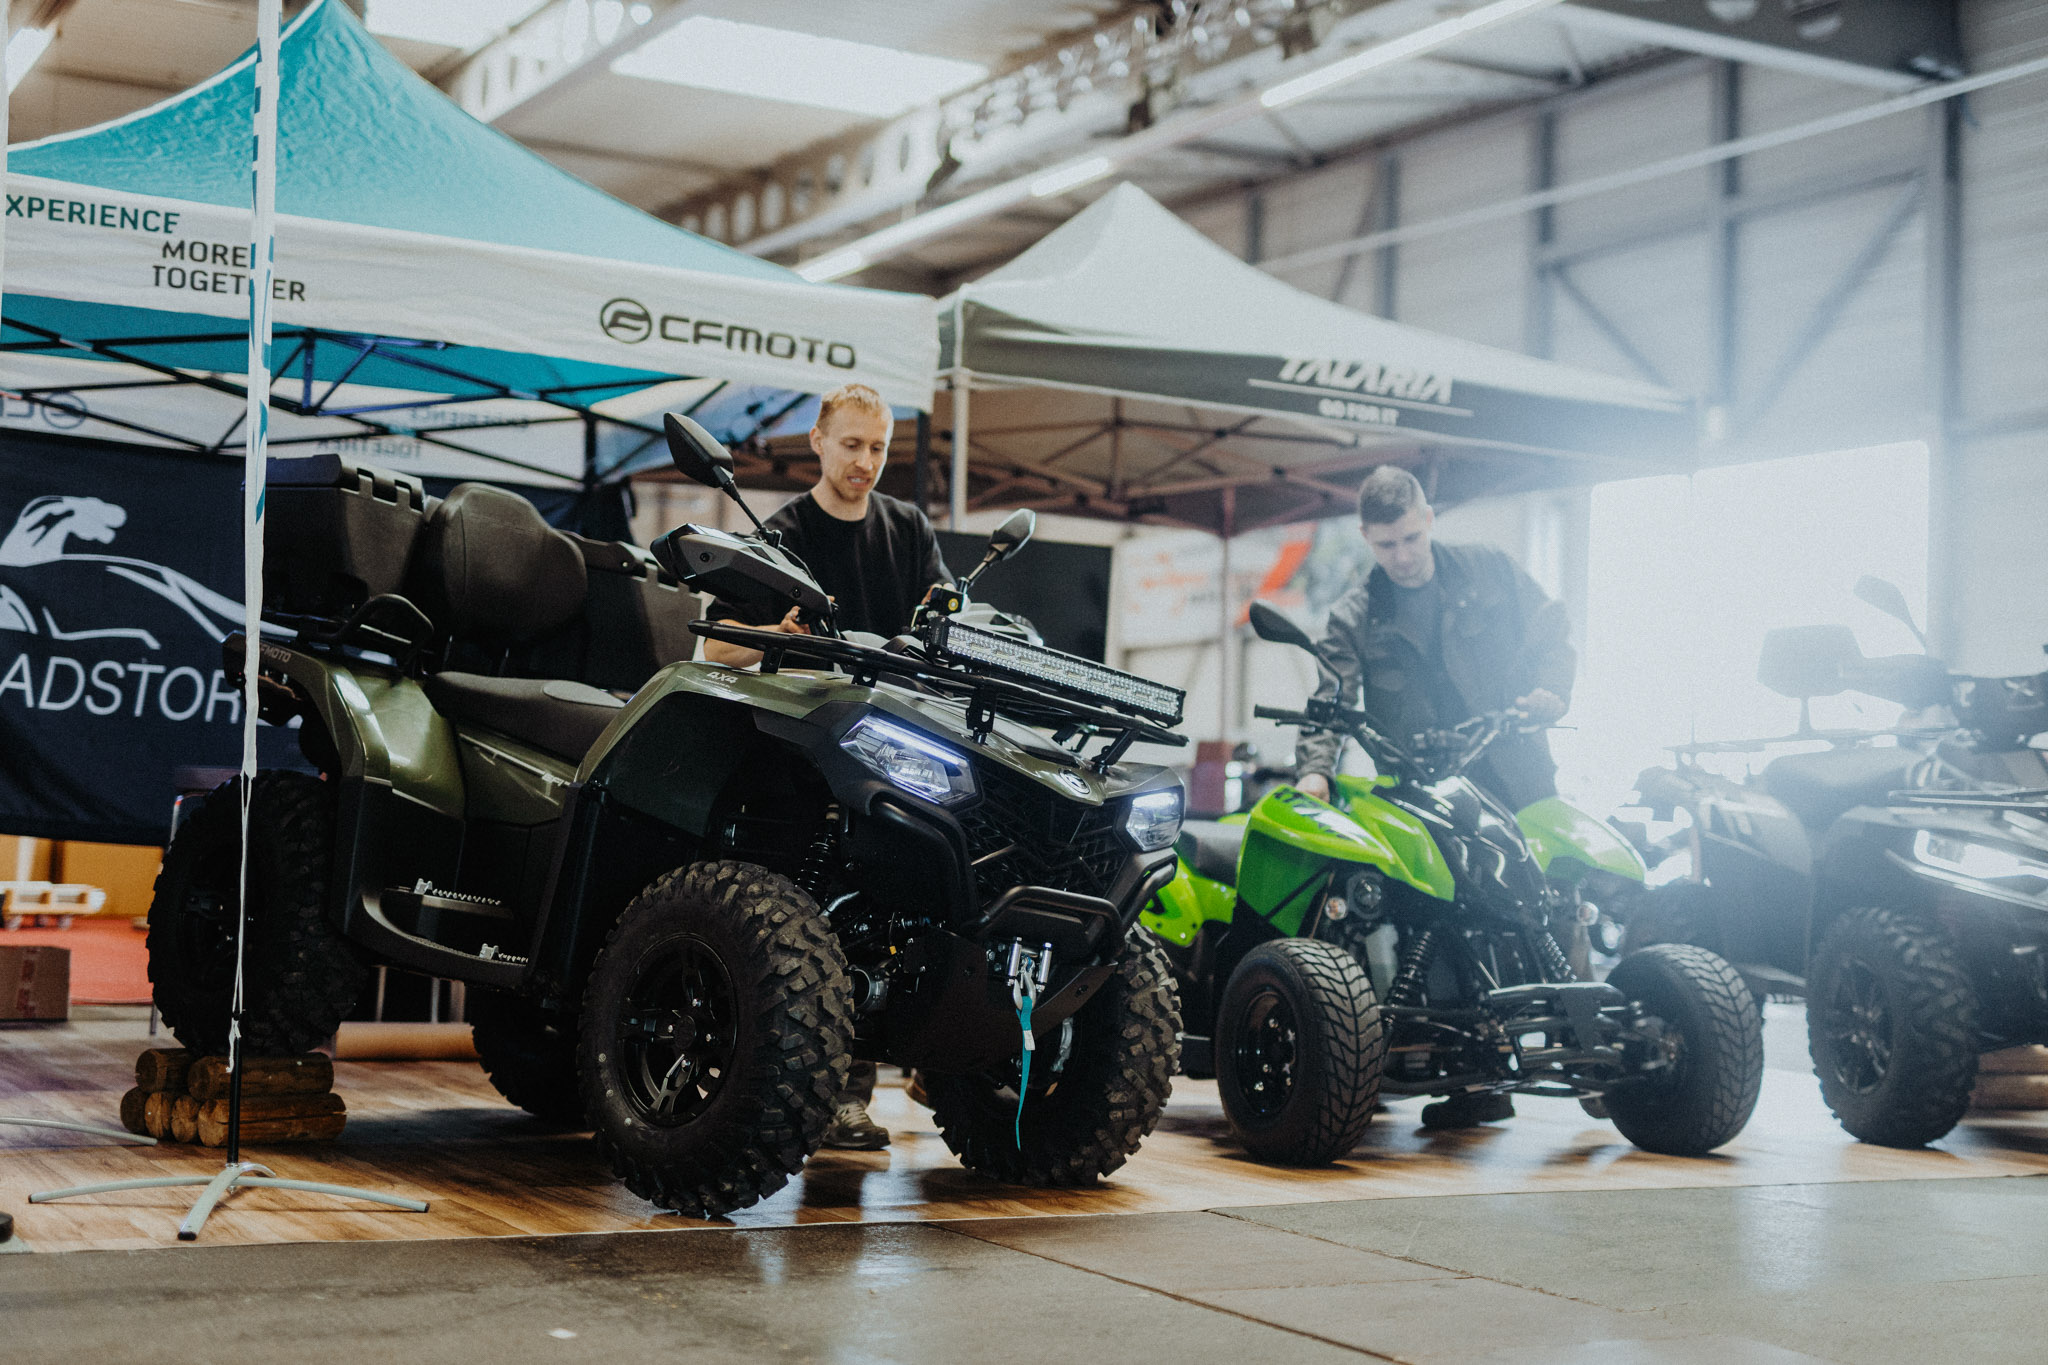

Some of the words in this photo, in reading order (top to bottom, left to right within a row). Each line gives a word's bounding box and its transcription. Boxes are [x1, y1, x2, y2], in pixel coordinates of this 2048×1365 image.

[5, 193, 181, 234] XPERIENCE
[161, 240, 249, 268] MORE
[152, 265, 305, 302] TOGETER
[660, 314, 856, 370] CFMOTO
[259, 642, 293, 663] FMOTO
[0, 652, 303, 730] ADSTOR
